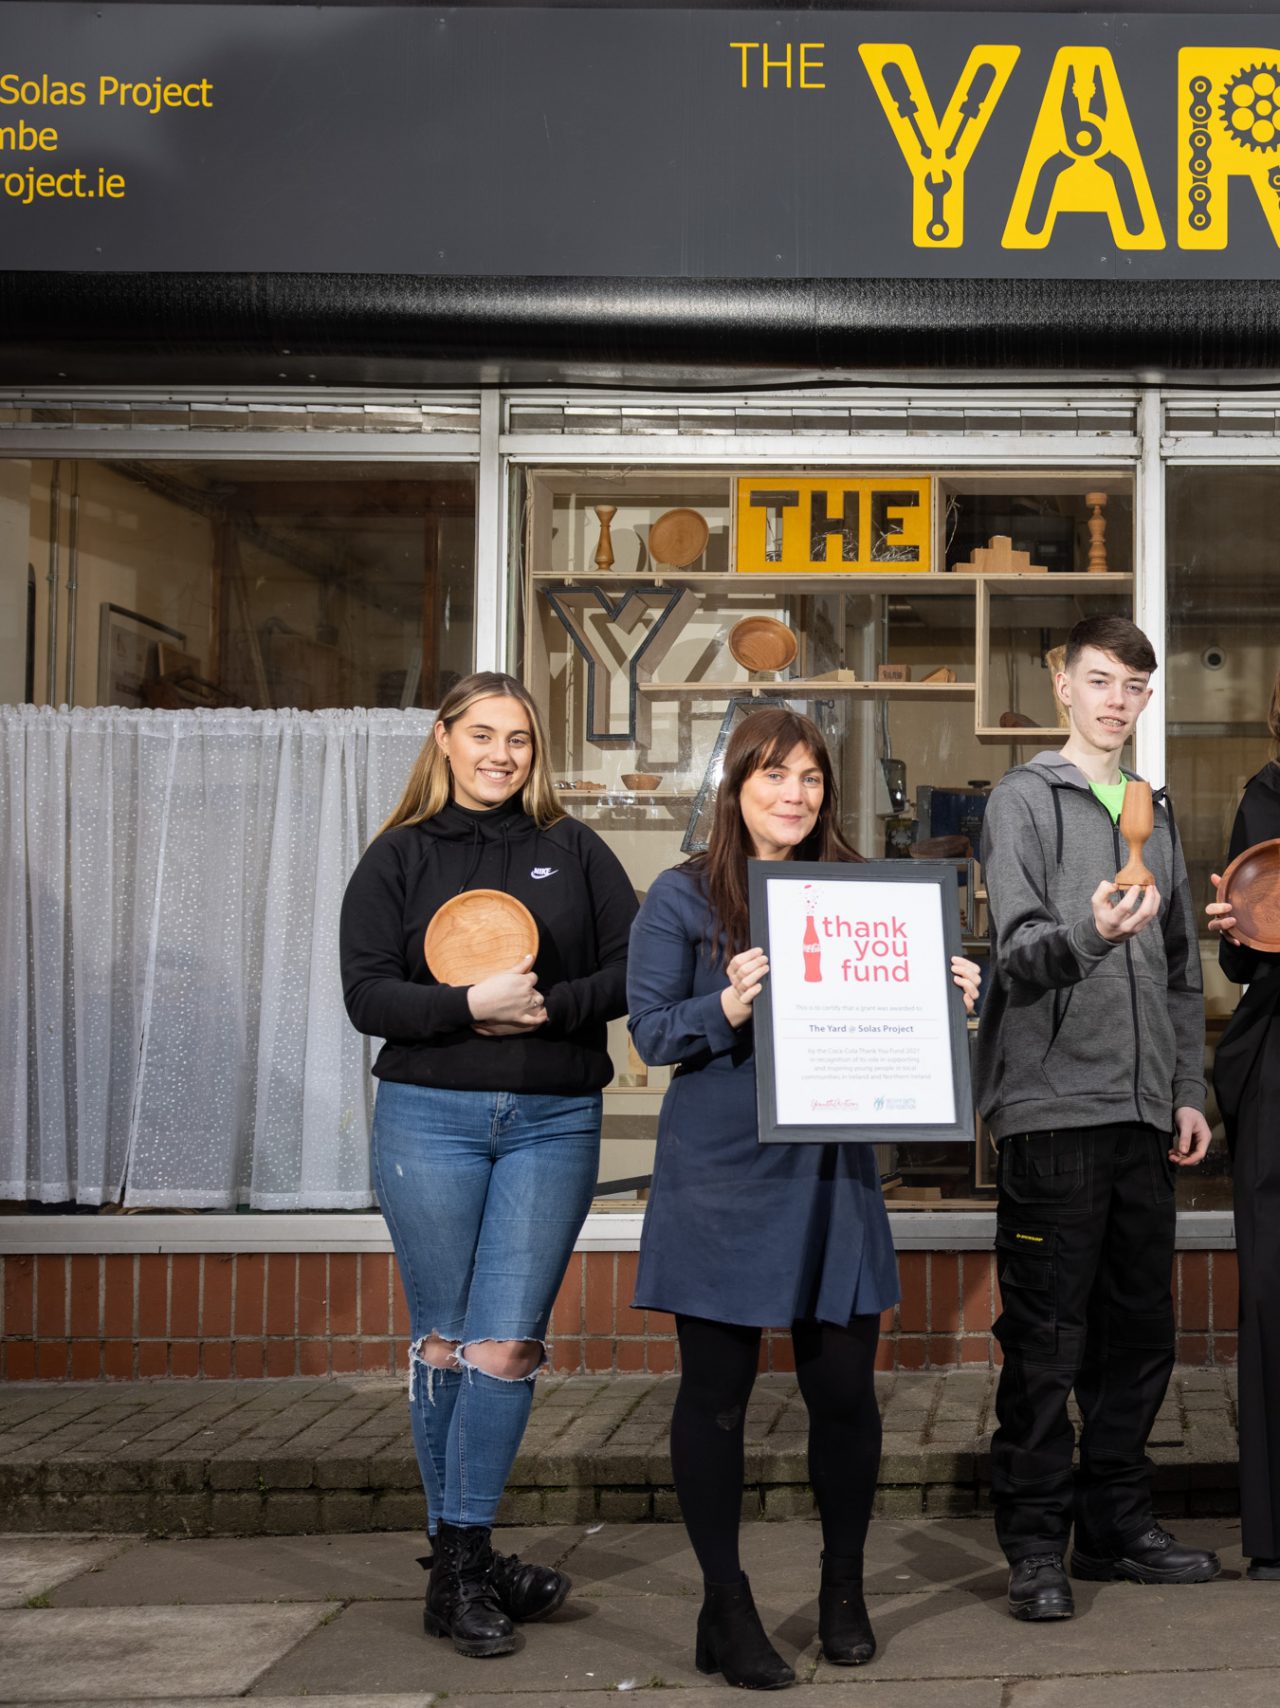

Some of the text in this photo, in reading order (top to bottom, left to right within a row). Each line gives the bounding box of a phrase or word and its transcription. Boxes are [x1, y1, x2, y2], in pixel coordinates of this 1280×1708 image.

[730, 43, 825, 88] THE
[0, 74, 213, 113] Solas Project
[750, 490, 919, 562] THE
[823, 915, 907, 938] thank
[855, 941, 908, 960] you
[842, 959, 909, 982] fund
[858, 1025, 881, 1033] Solas
[883, 1025, 914, 1034] Project
